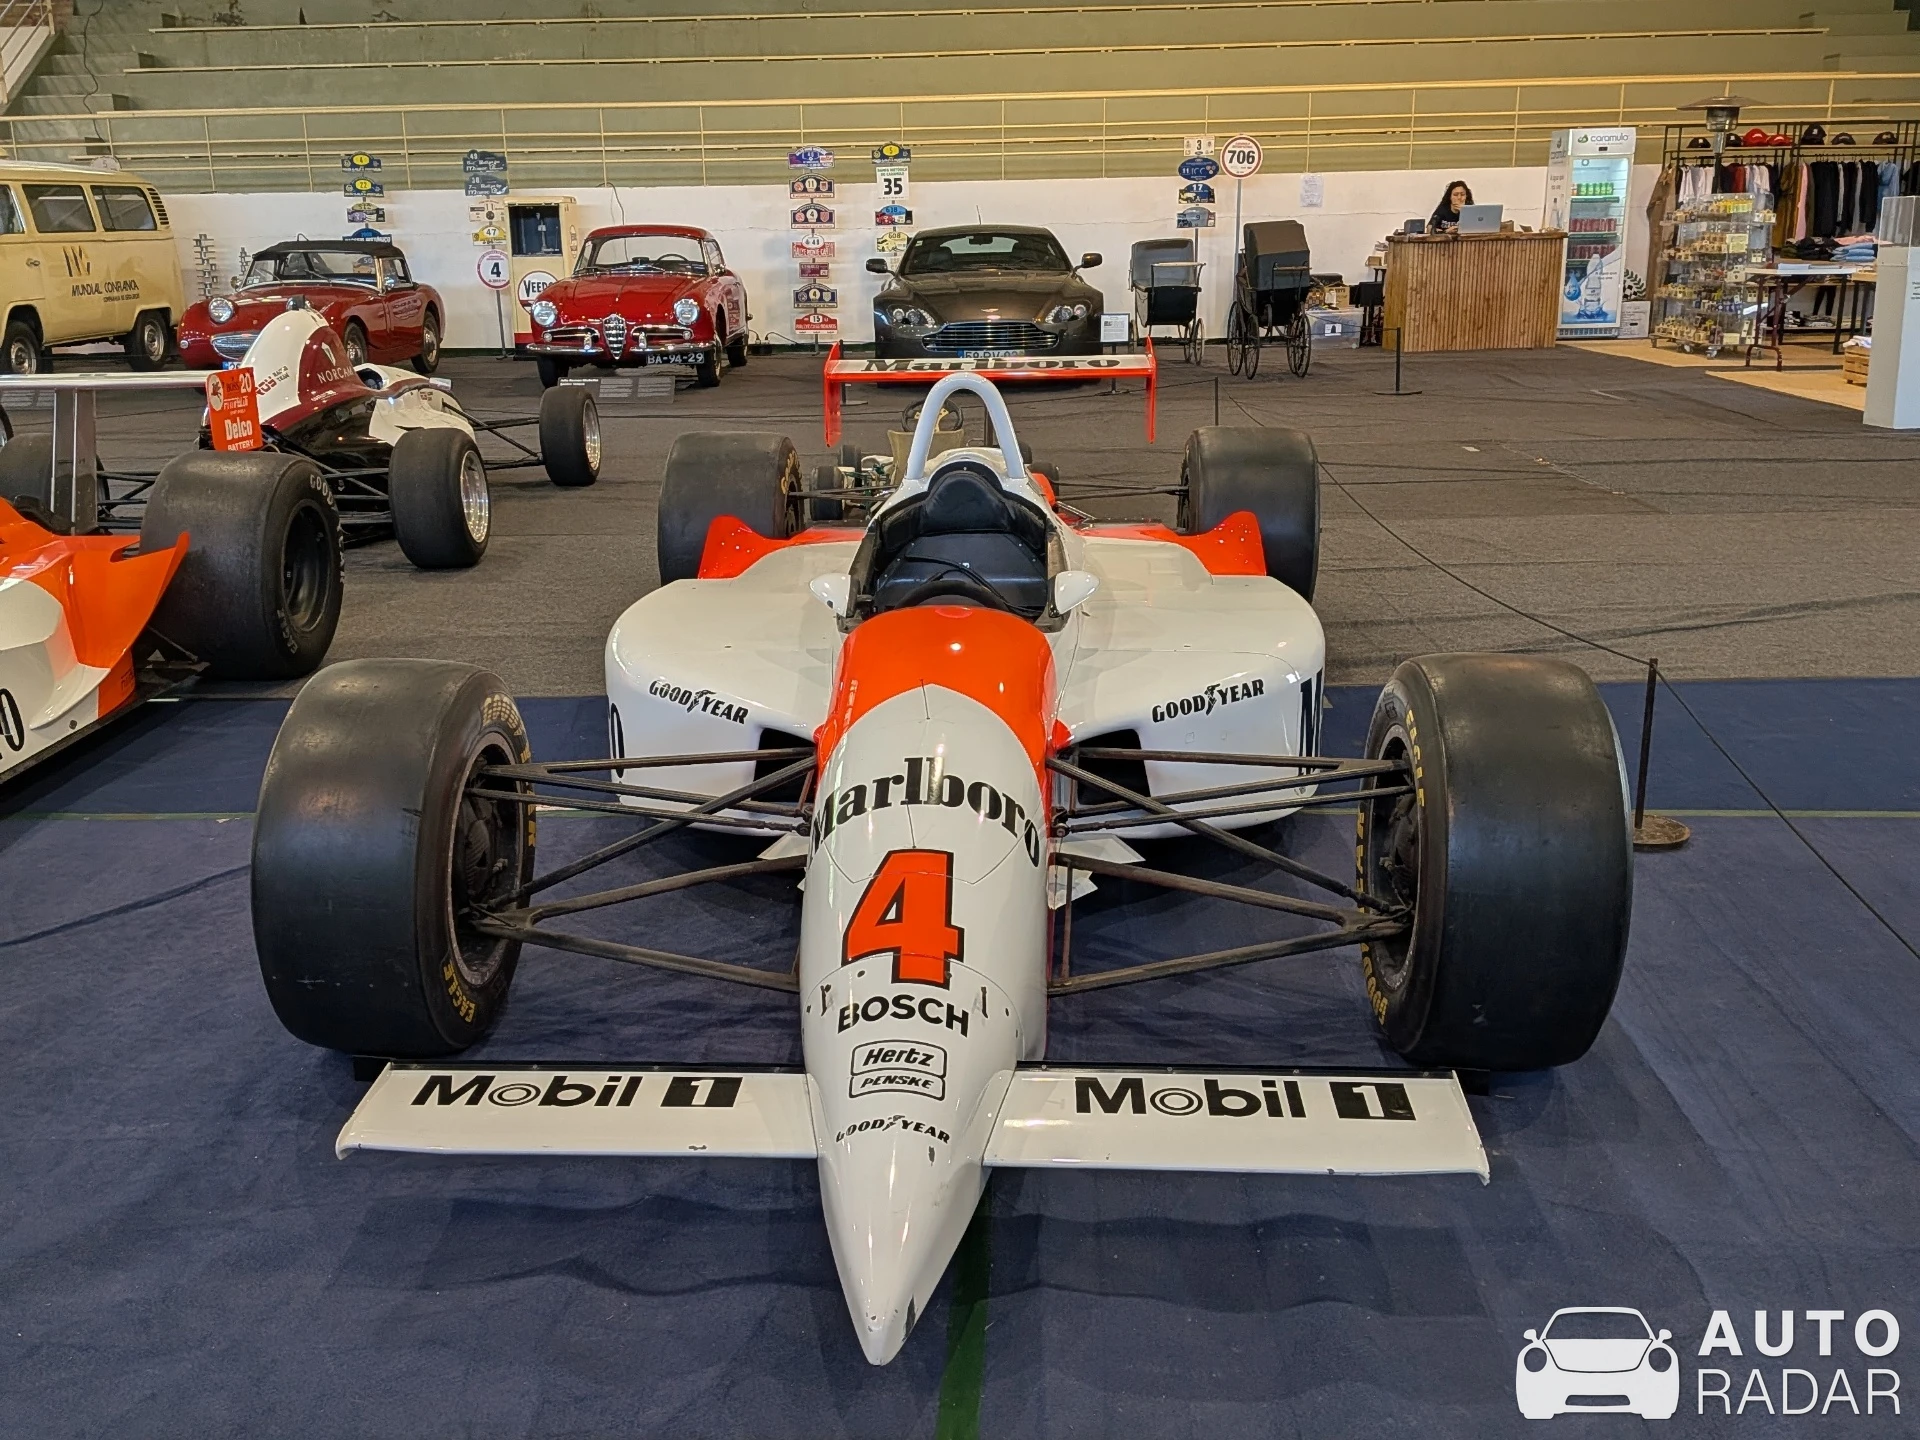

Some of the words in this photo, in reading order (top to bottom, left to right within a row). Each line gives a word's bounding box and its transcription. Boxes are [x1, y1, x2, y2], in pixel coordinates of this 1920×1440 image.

[1196, 139, 1202, 150] 3
[1590, 133, 1629, 142] caramulo
[1227, 149, 1256, 165] 706
[359, 181, 368, 189] 22
[883, 177, 903, 195] 35
[1192, 183, 1204, 191] 17
[486, 228, 497, 236] 47
[490, 261, 502, 278] 4
[812, 315, 821, 323] 15
[861, 357, 1121, 372] Marlboro
[239, 373, 252, 393] 20
[224, 417, 253, 440] Delco
[227, 438, 254, 451] BATTERY
[808, 757, 1040, 868] Marlboro
[841, 848, 965, 991] 4
[837, 994, 970, 1038] BOSCH
[862, 1047, 935, 1067] Hertz
[859, 1075, 935, 1090] PENSKE
[410, 1075, 644, 1108] Mobil
[1074, 1077, 1307, 1118] Mobil
